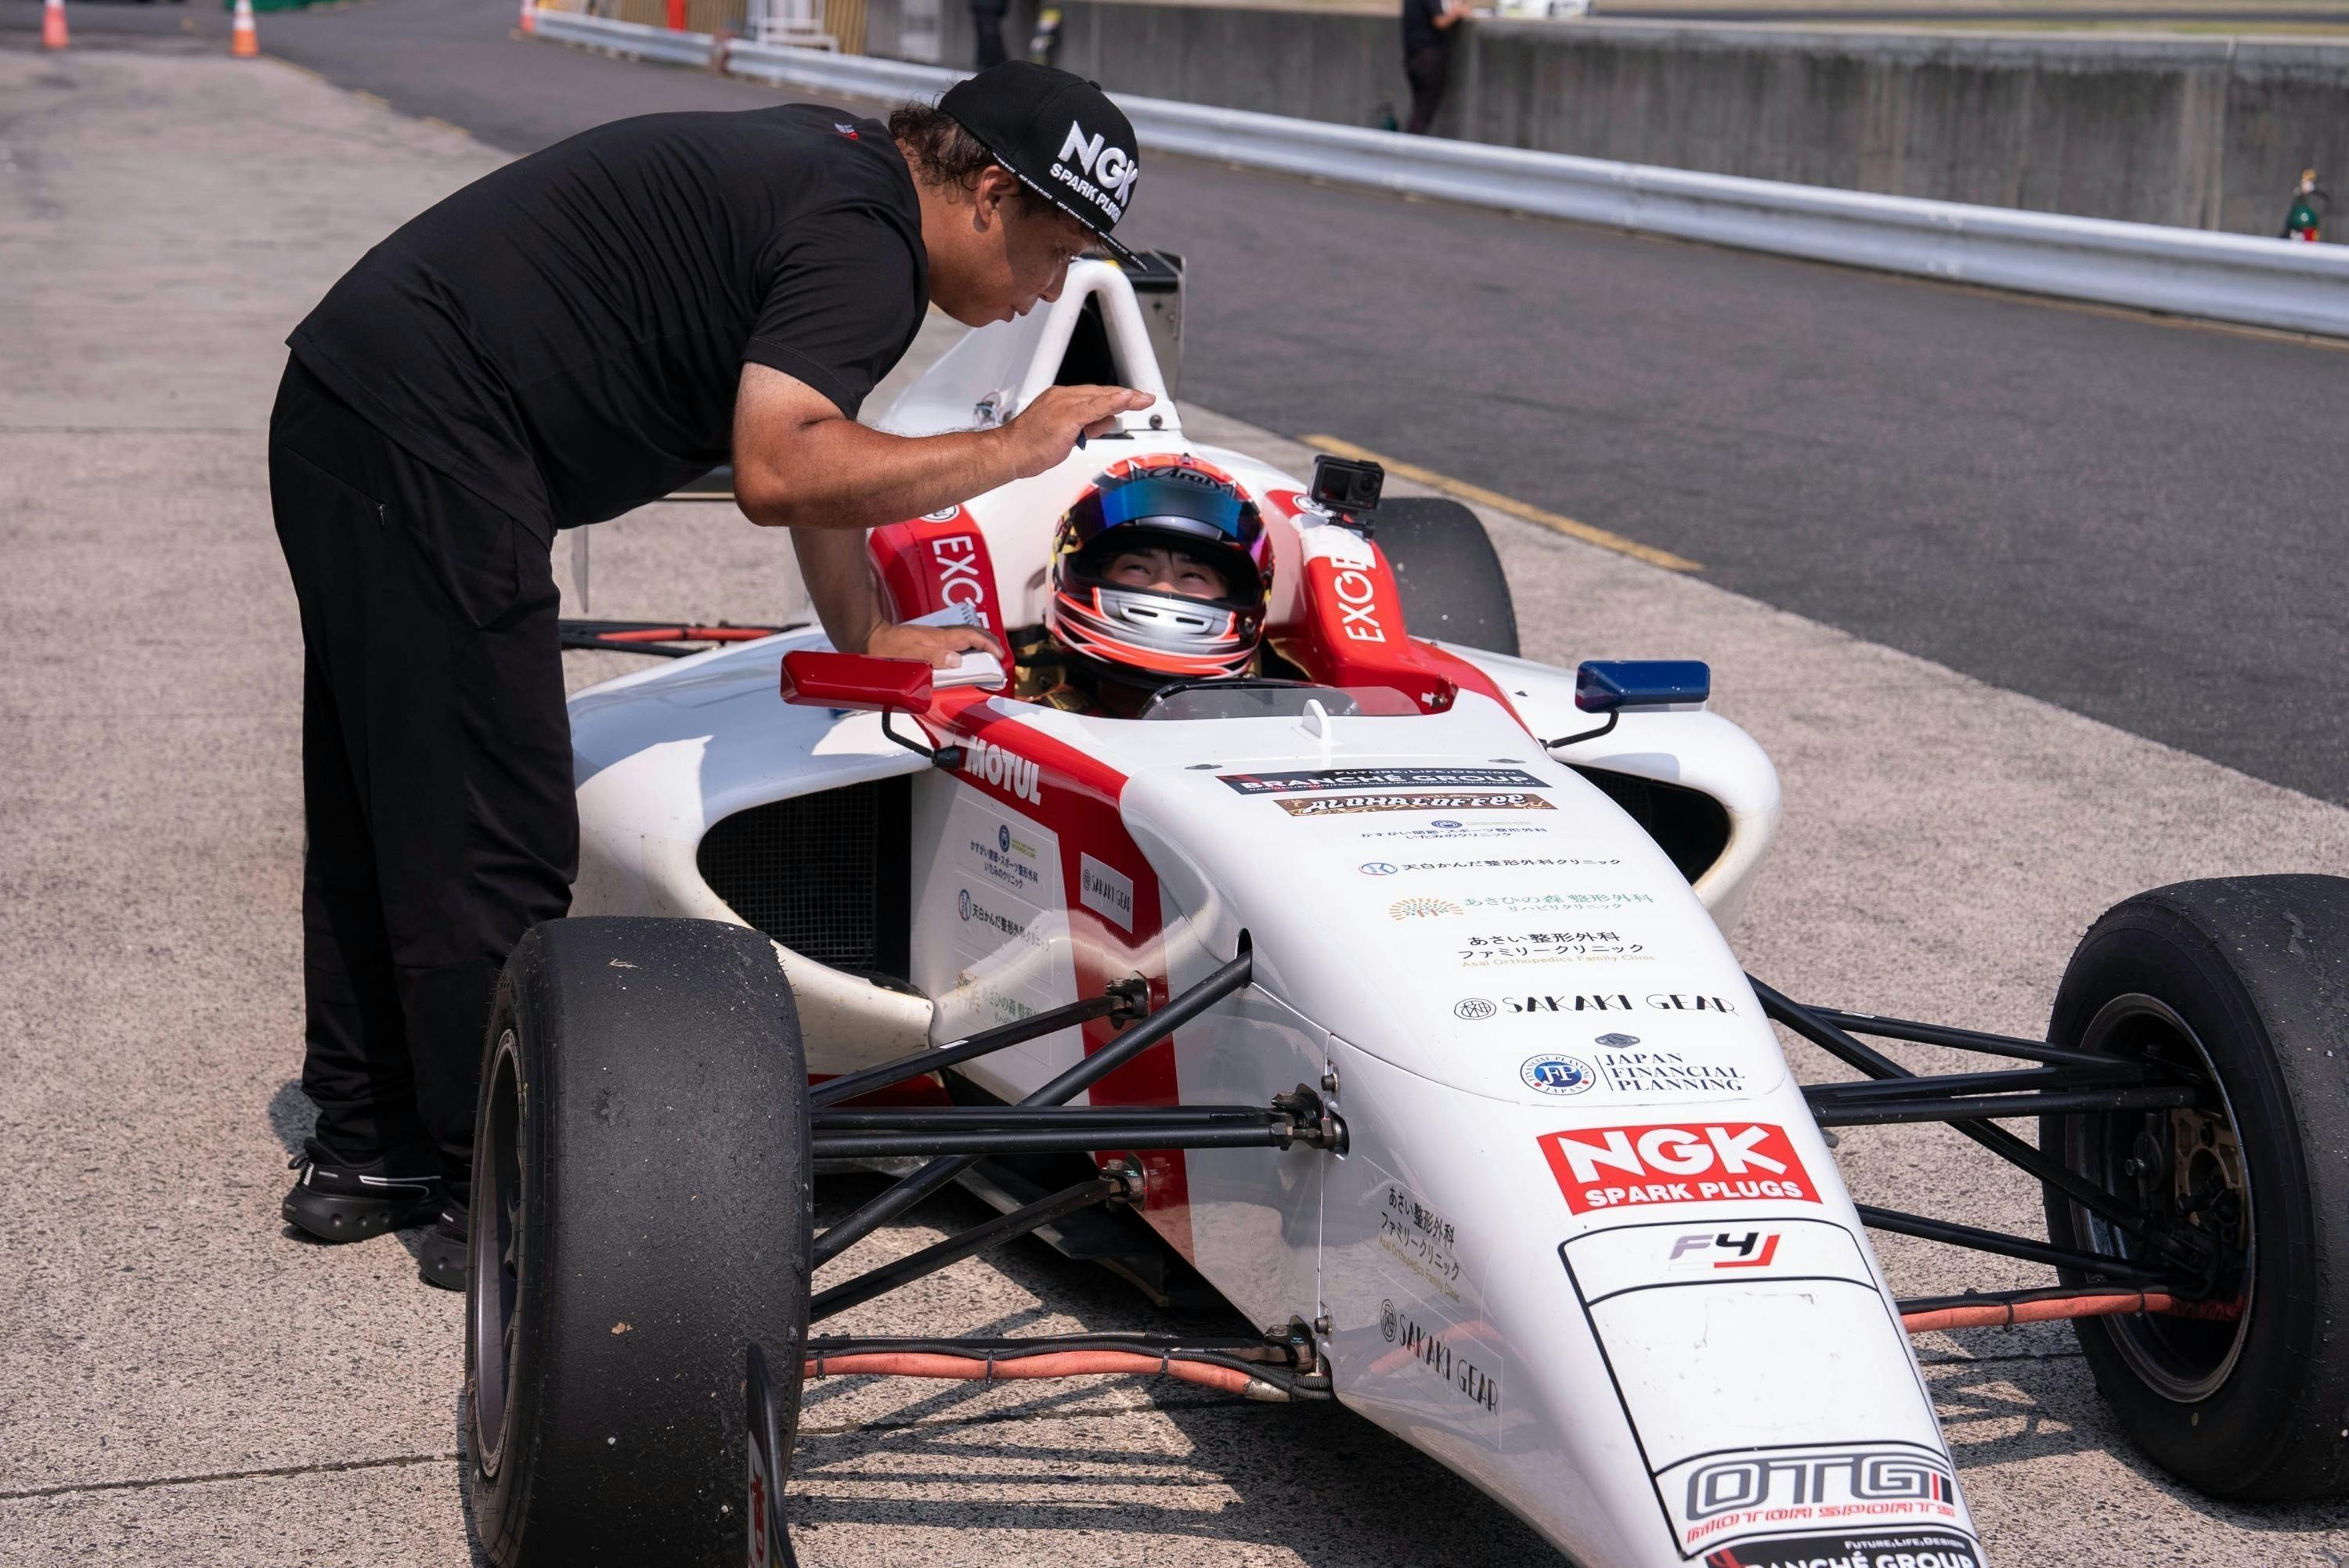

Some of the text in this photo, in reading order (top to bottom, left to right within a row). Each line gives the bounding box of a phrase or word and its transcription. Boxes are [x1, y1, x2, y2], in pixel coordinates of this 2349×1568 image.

[1057, 120, 1138, 207] NGK
[1049, 163, 1099, 202] SPARK
[965, 734, 1043, 806] MOTUL
[1240, 774, 1406, 788] BRANCHÉ
[1402, 859, 1622, 871] 天白かんだ整形外科クリニック
[1092, 875, 1114, 902] SAKAKI
[1465, 893, 1654, 907] あさひの森 整形外科
[1467, 931, 1621, 946] あさい整形外科
[1458, 944, 1644, 960] ファミリークリニック
[1492, 956, 1573, 967] Orthopedics
[1577, 955, 1618, 964] Family
[1503, 994, 1633, 1012] SAKAKI
[1646, 993, 1740, 1017] GEAR
[1606, 1053, 1684, 1066] JAPAN
[1611, 1066, 1745, 1079] FINANCIAL
[1618, 1080, 1743, 1091] PLANNING
[1557, 1125, 1788, 1184] NGK
[1585, 1181, 1804, 1207] SPARK PLUGS
[1388, 1186, 1455, 1251] あさい整形外科
[1380, 1211, 1460, 1281] ファミリークリニック
[1398, 1314, 1452, 1381] SAKAKI
[1457, 1359, 1499, 1416] GEAR
[1687, 1501, 1956, 1544] MOTOR SPORTS
